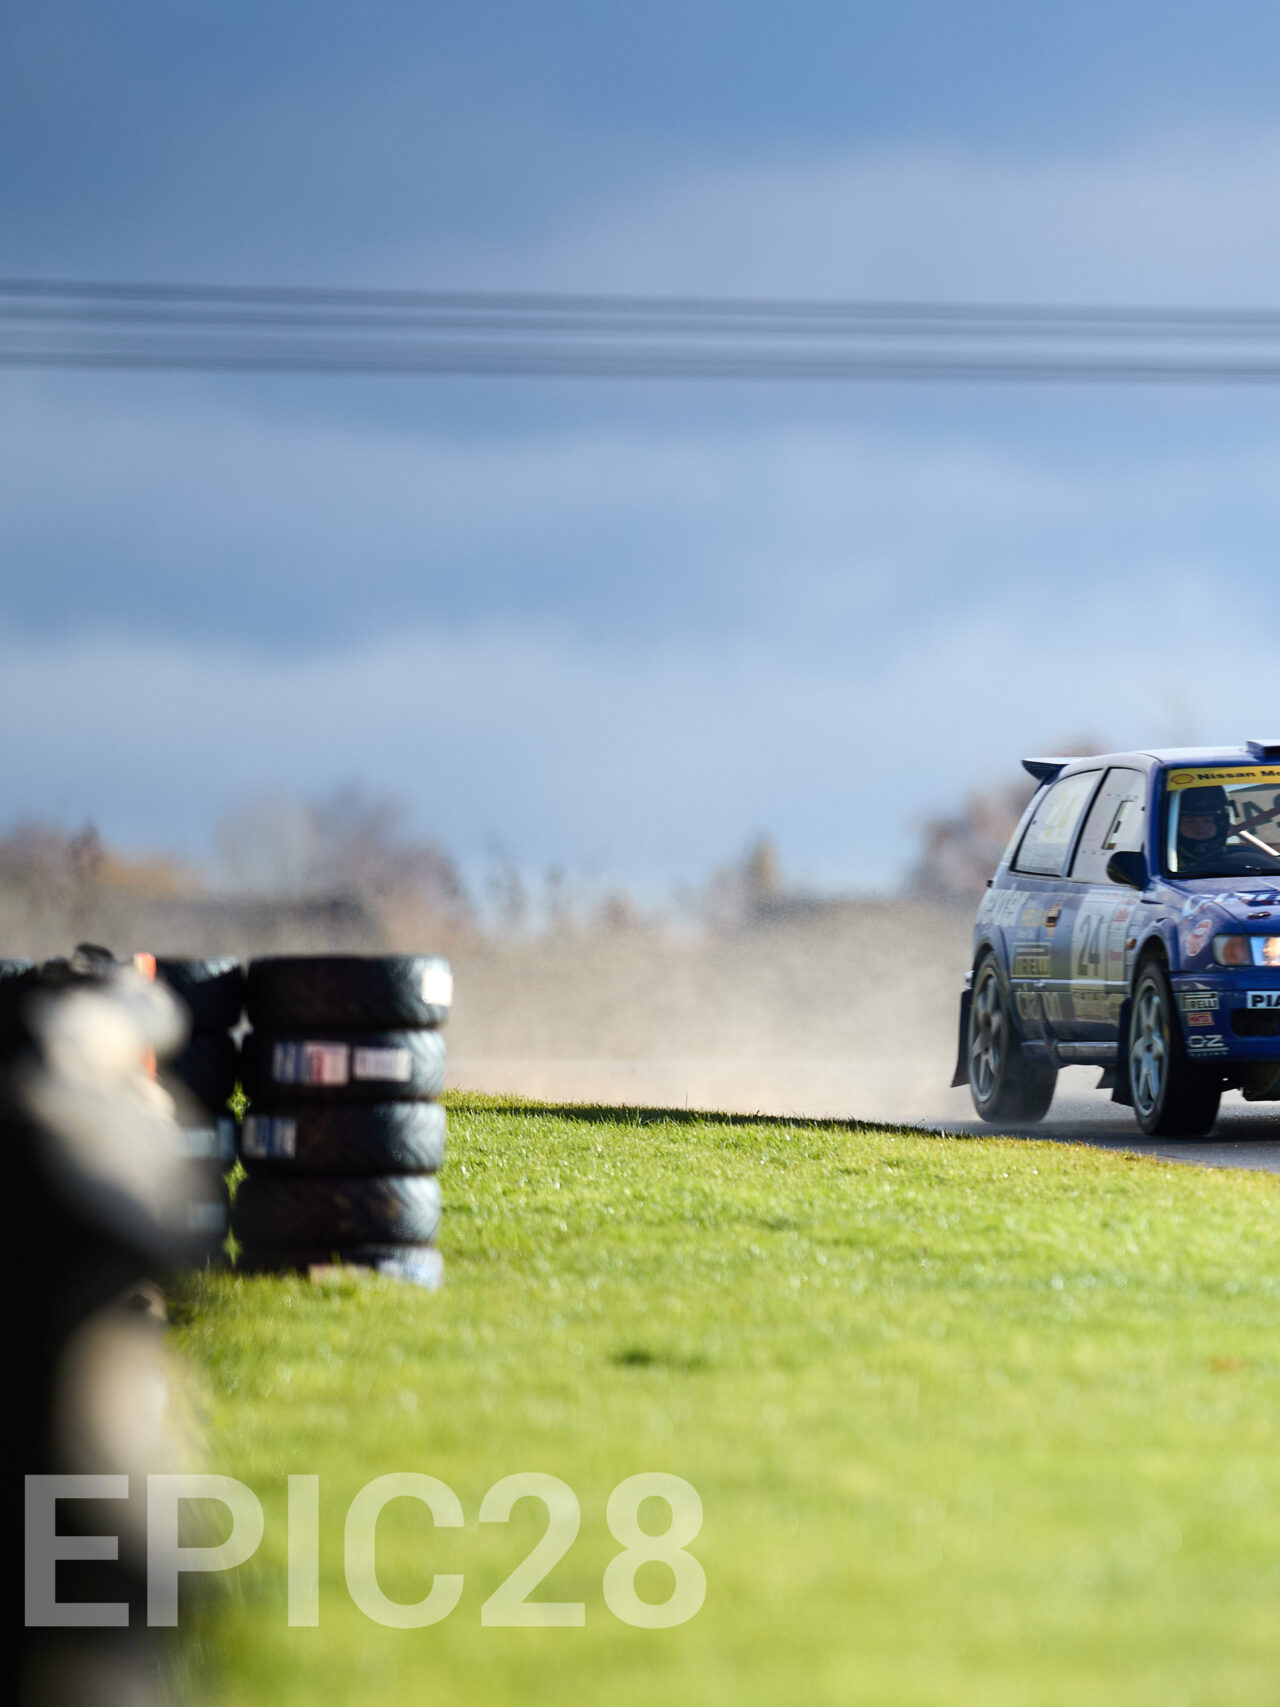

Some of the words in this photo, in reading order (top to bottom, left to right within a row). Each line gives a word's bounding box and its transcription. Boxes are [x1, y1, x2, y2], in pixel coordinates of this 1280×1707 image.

[1197, 770, 1257, 781] Nissan
[1077, 914, 1105, 977] 24
[1188, 1034, 1225, 1048] OZ
